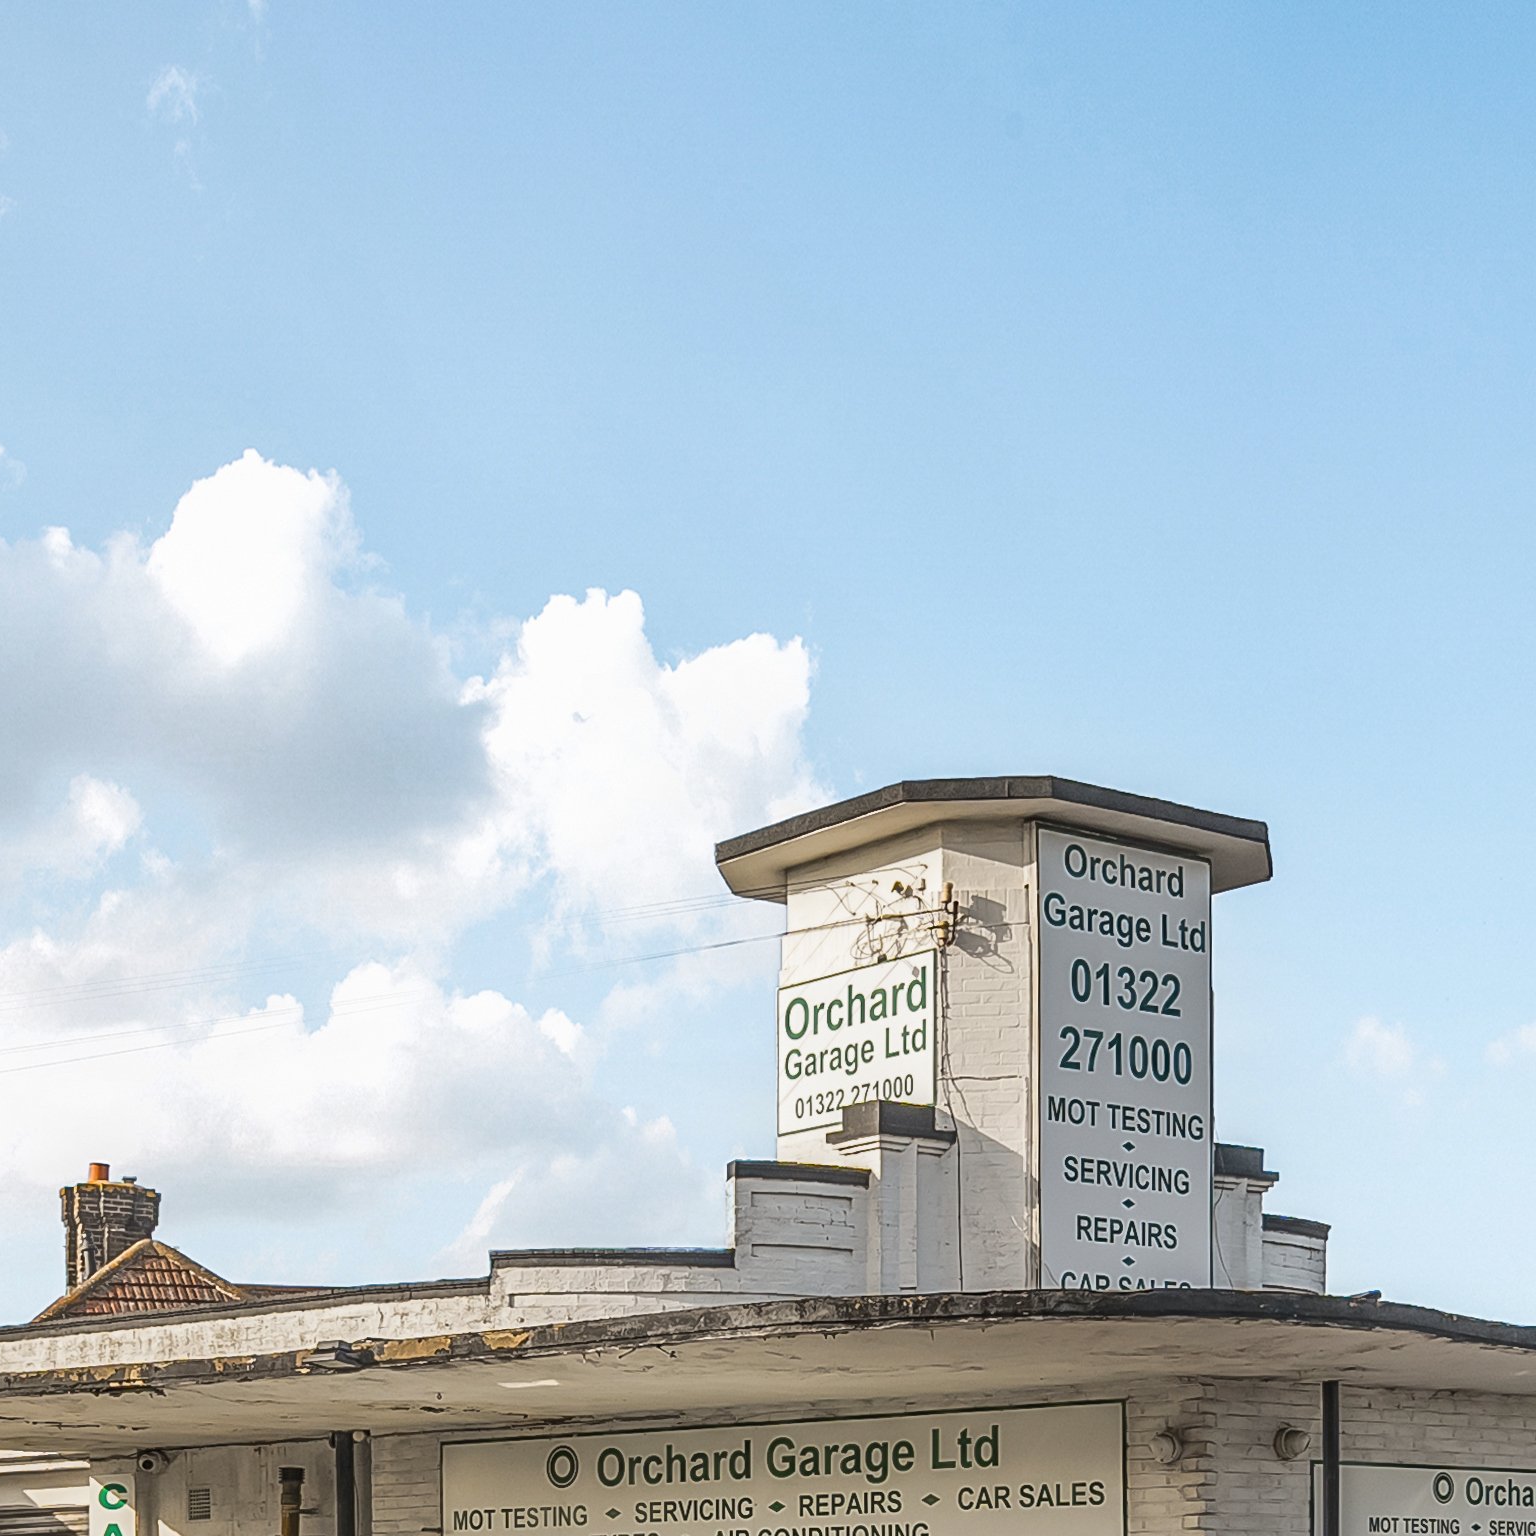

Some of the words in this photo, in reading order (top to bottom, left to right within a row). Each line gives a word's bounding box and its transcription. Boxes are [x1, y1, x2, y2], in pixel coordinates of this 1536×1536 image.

[1064, 843, 1184, 898] Orchard
[1044, 892, 1152, 948] Garage
[1162, 913, 1206, 953] Ltd
[785, 966, 927, 1040] Orchard
[1071, 958, 1182, 1018] 01322
[785, 1040, 875, 1080] Garage
[885, 1019, 927, 1059] Ltd
[1059, 1025, 1193, 1086] 271000
[795, 1088, 845, 1119] 01322
[851, 1074, 914, 1105] 271000
[1047, 1095, 1100, 1127] MOT
[1107, 1103, 1204, 1140] TESTING
[1064, 1155, 1190, 1195] SERVICING
[1076, 1214, 1178, 1250] REPAIRS
[597, 1439, 752, 1487] Orchard
[766, 1436, 915, 1484] Garage
[931, 1424, 1000, 1470] Ltd
[453, 1509, 496, 1531] MOT
[501, 1505, 588, 1529] TESTING
[635, 1498, 754, 1524] SERVICING
[799, 1490, 903, 1517] REPAIRS
[957, 1485, 1011, 1511] CAR
[1019, 1481, 1105, 1508] SALES
[1368, 1517, 1399, 1534] MOT
[1403, 1518, 1460, 1535] TESTING
